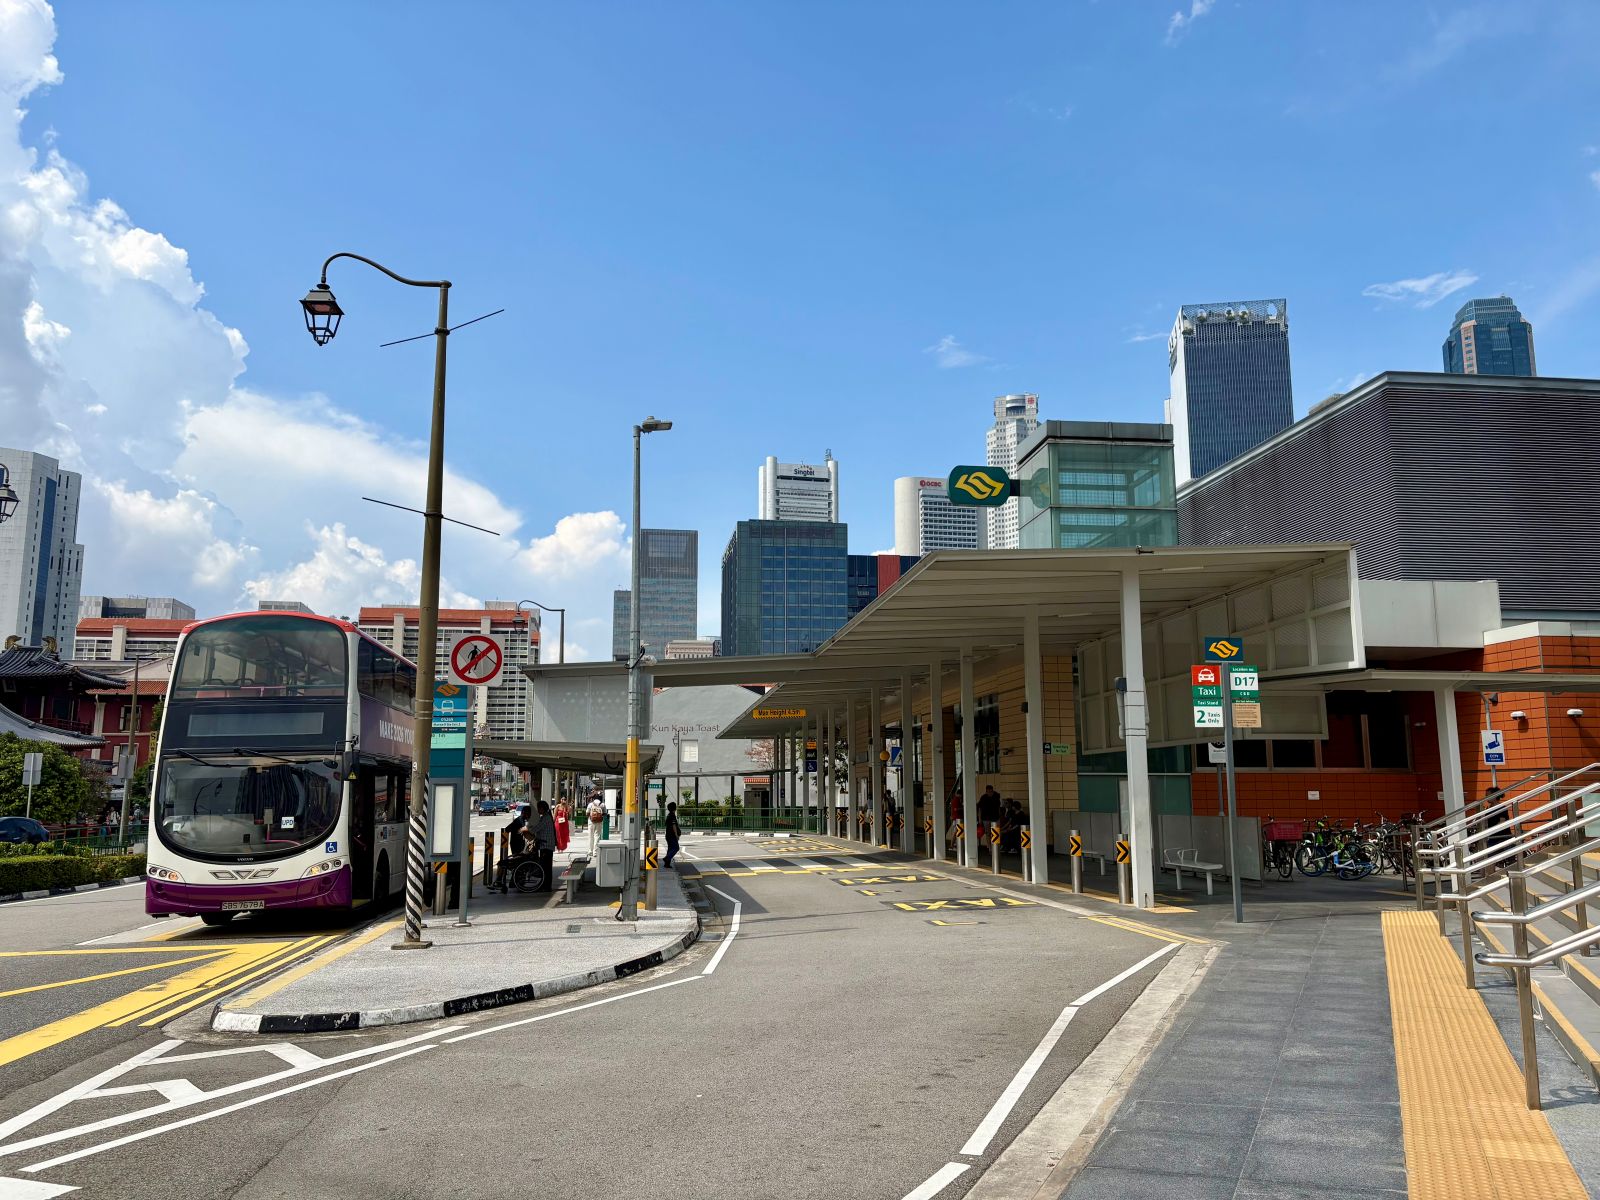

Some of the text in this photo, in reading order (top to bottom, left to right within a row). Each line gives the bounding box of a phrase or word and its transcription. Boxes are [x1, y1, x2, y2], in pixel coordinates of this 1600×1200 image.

[794, 468, 815, 477] Singtel
[1234, 676, 1255, 686] D17
[1198, 687, 1216, 696] Taxi
[770, 708, 787, 717] Height
[1196, 710, 1206, 723] 2
[379, 719, 393, 740] MAKE
[651, 723, 720, 735] Kun Kaya Toast
